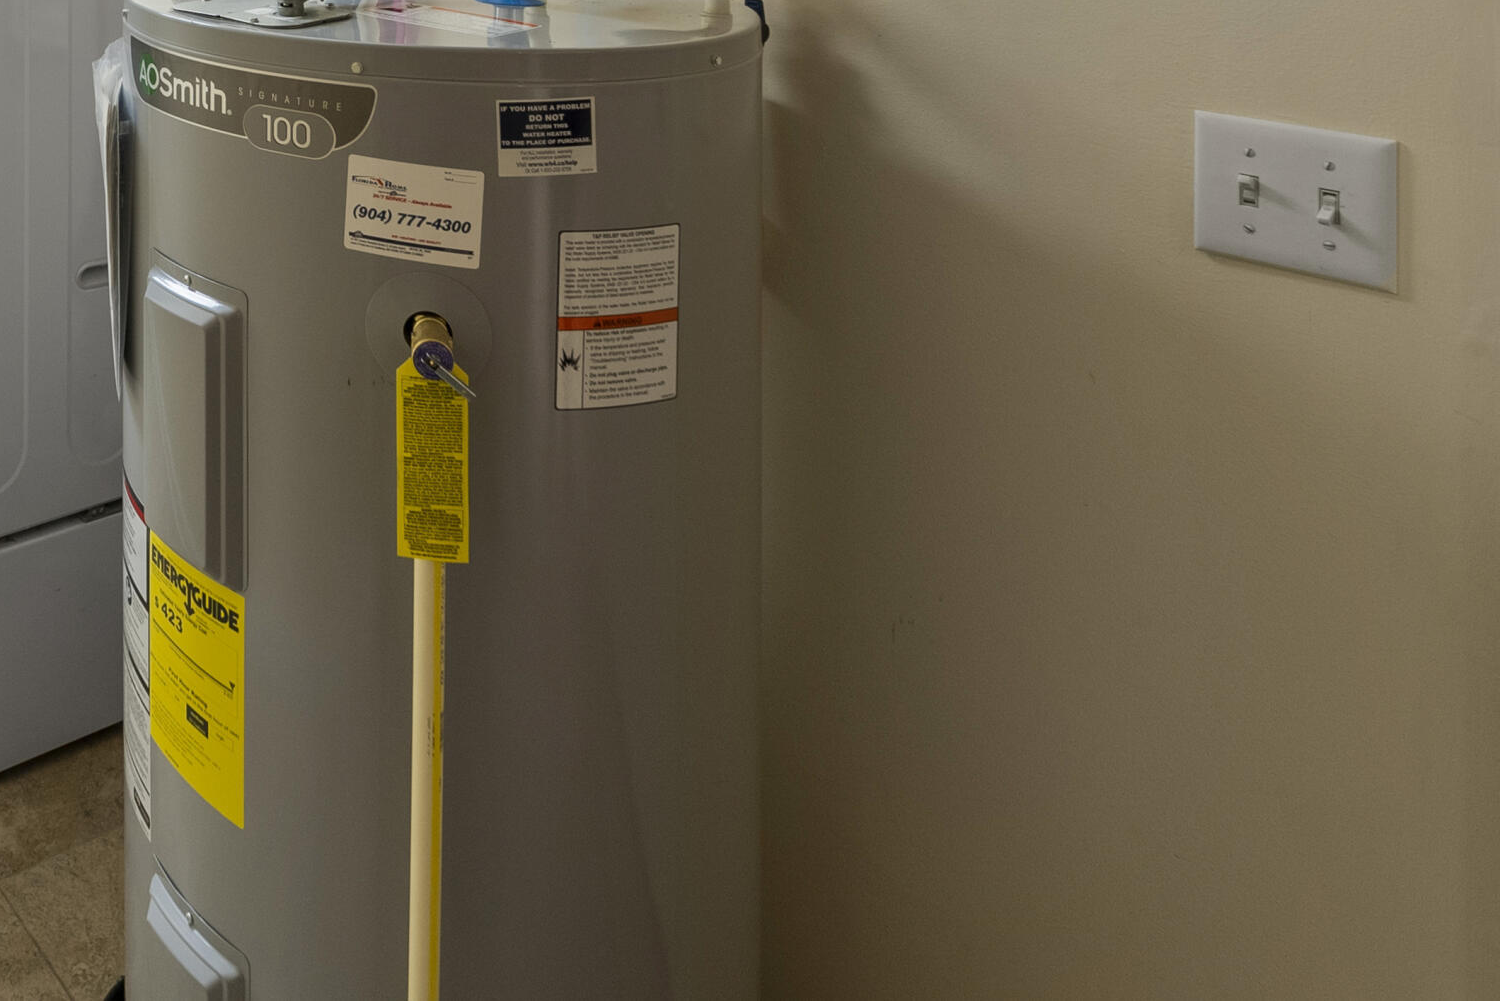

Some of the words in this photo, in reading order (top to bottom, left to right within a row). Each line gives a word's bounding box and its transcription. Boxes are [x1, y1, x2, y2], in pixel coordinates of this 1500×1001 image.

[238, 86, 342, 112] SIGNATURE
[262, 113, 311, 149] 100
[528, 114, 543, 122] DO
[385, 194, 407, 203] SERVICE
[353, 204, 392, 225] (904)
[397, 212, 472, 234] 777-4300
[602, 317, 642, 327] WARNING
[161, 601, 184, 634] 423
